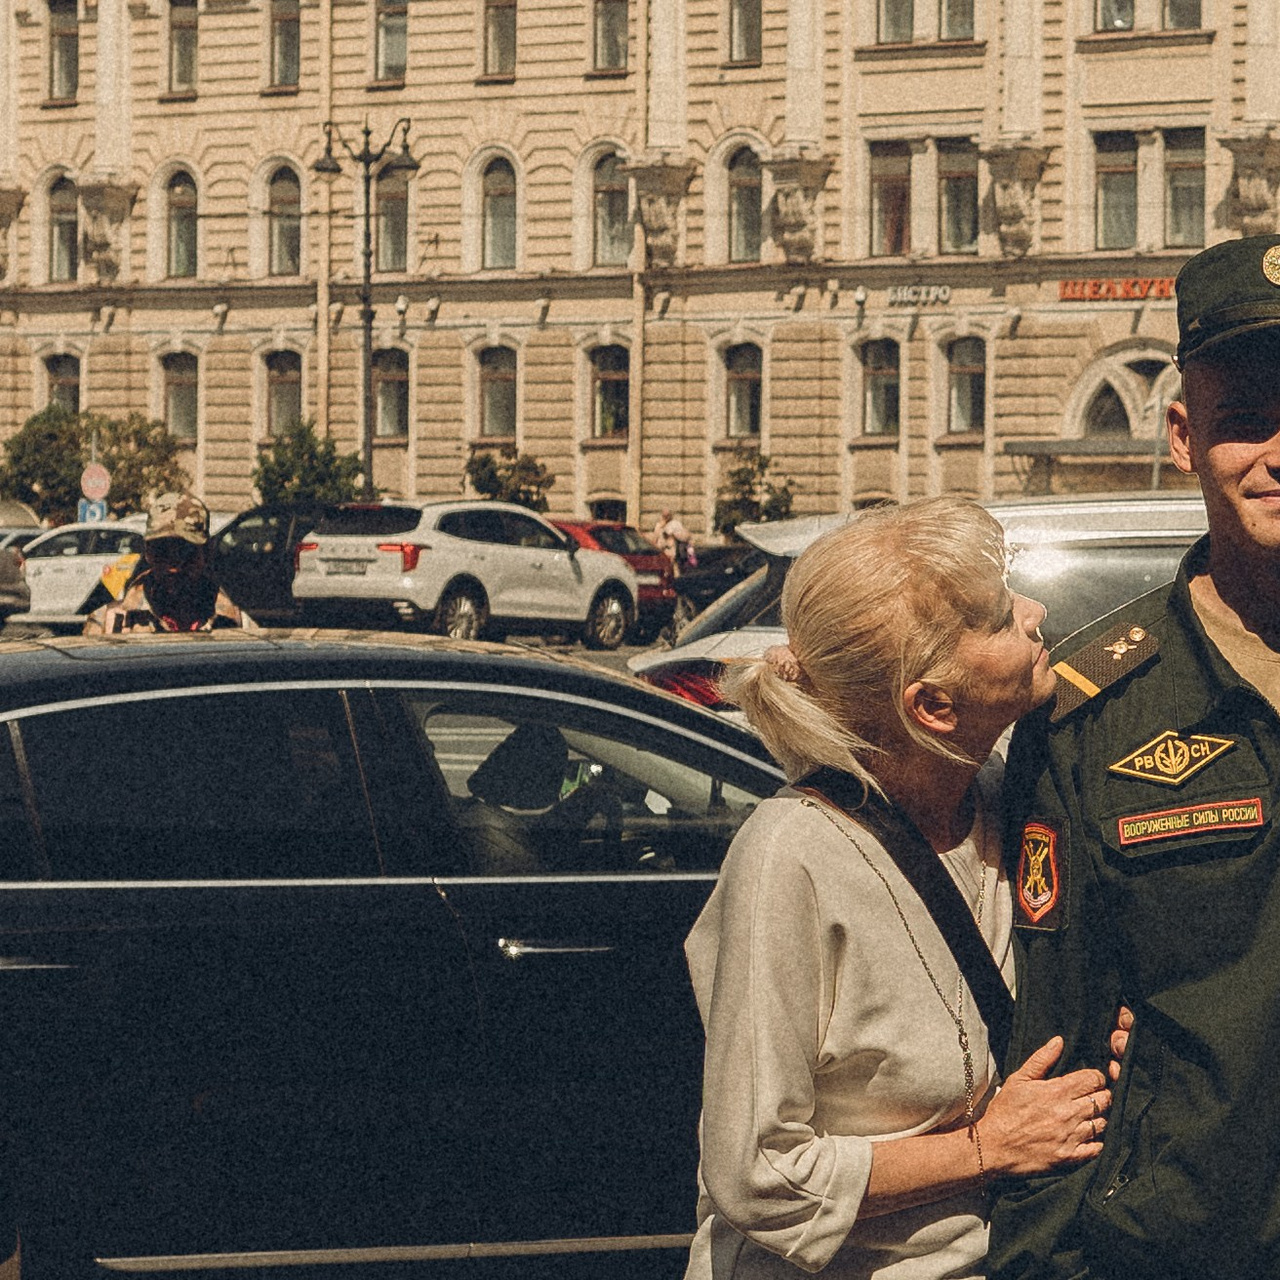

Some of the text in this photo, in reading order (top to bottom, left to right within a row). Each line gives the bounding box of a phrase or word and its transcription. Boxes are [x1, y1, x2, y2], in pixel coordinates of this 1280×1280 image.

[1134, 741, 1211, 771] РВ СН
[1123, 806, 1258, 838] ВООРУЖЕННЫЕ СИЛЫ РОССИИ
